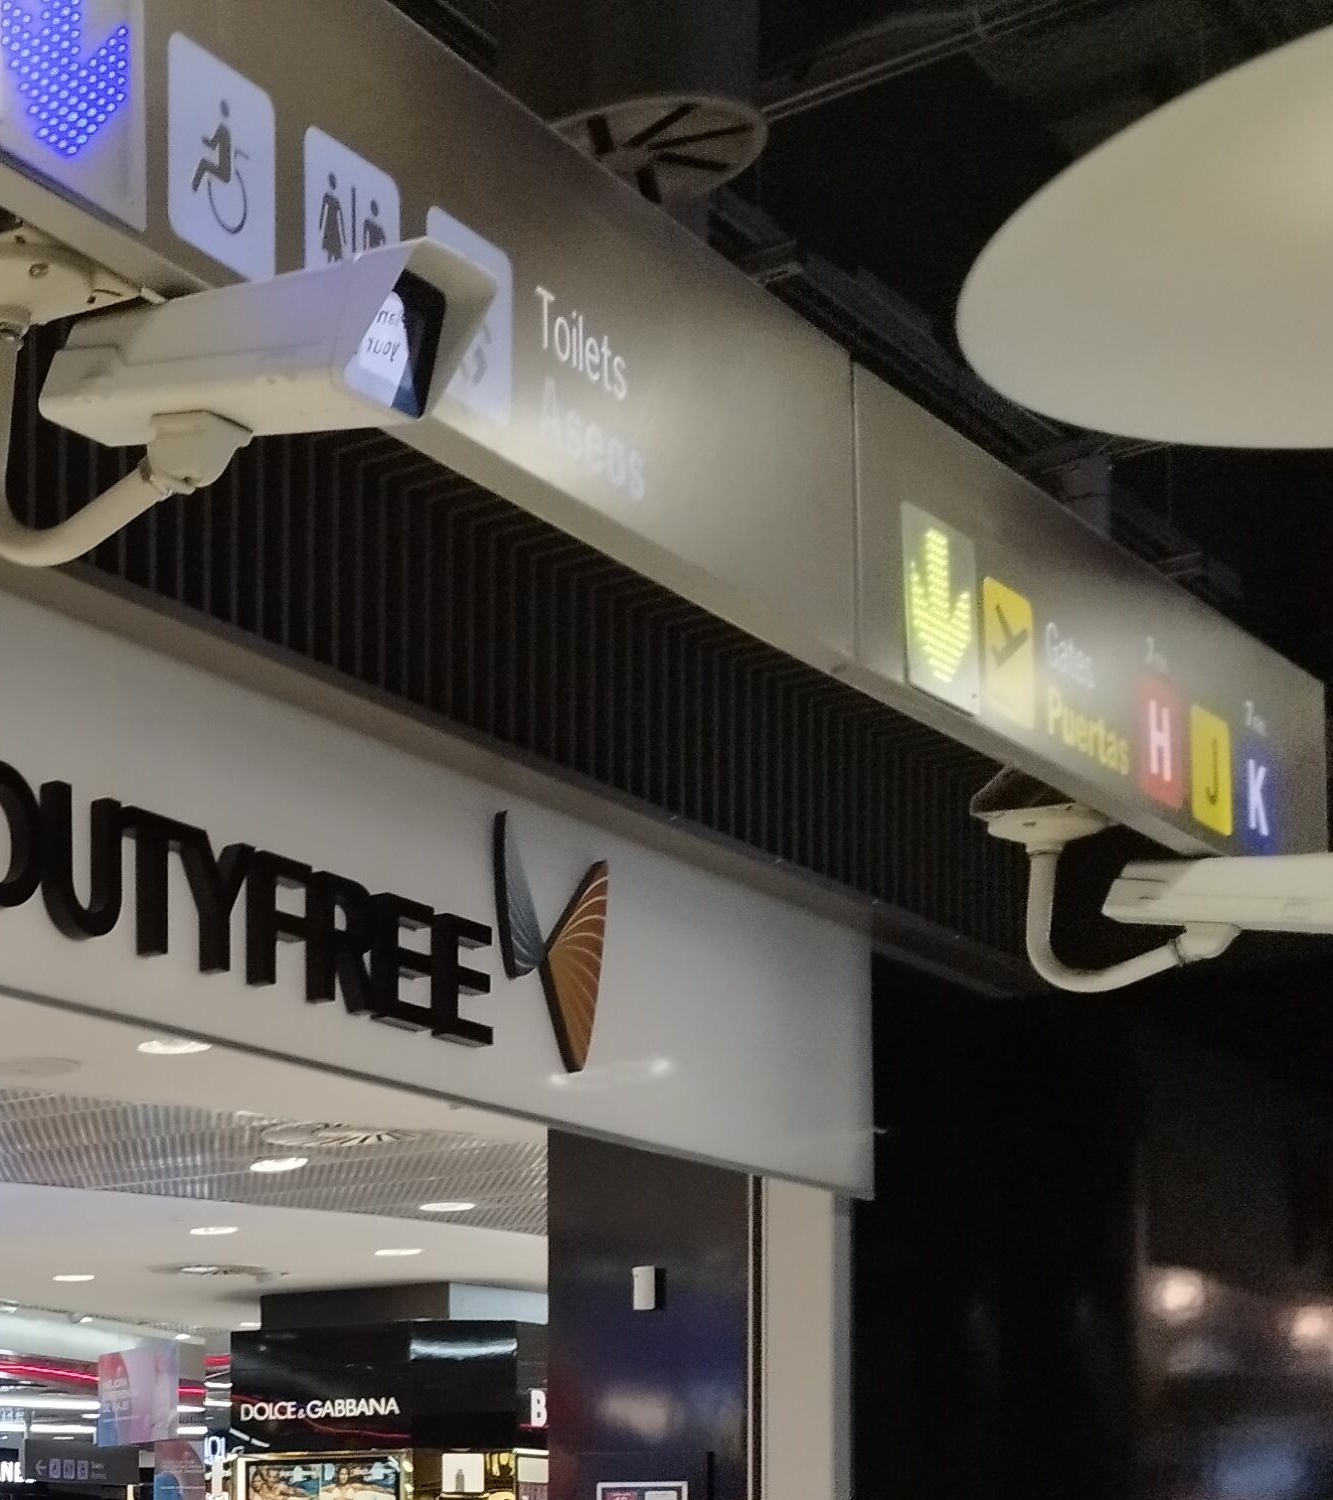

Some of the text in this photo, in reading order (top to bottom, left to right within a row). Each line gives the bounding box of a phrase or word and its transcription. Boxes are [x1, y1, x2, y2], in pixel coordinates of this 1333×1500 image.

[535, 285, 627, 400] Toilets
[539, 376, 644, 500] Aseos
[1045, 622, 1095, 688] Gates
[1048, 688, 1269, 836] Puertas H J K
